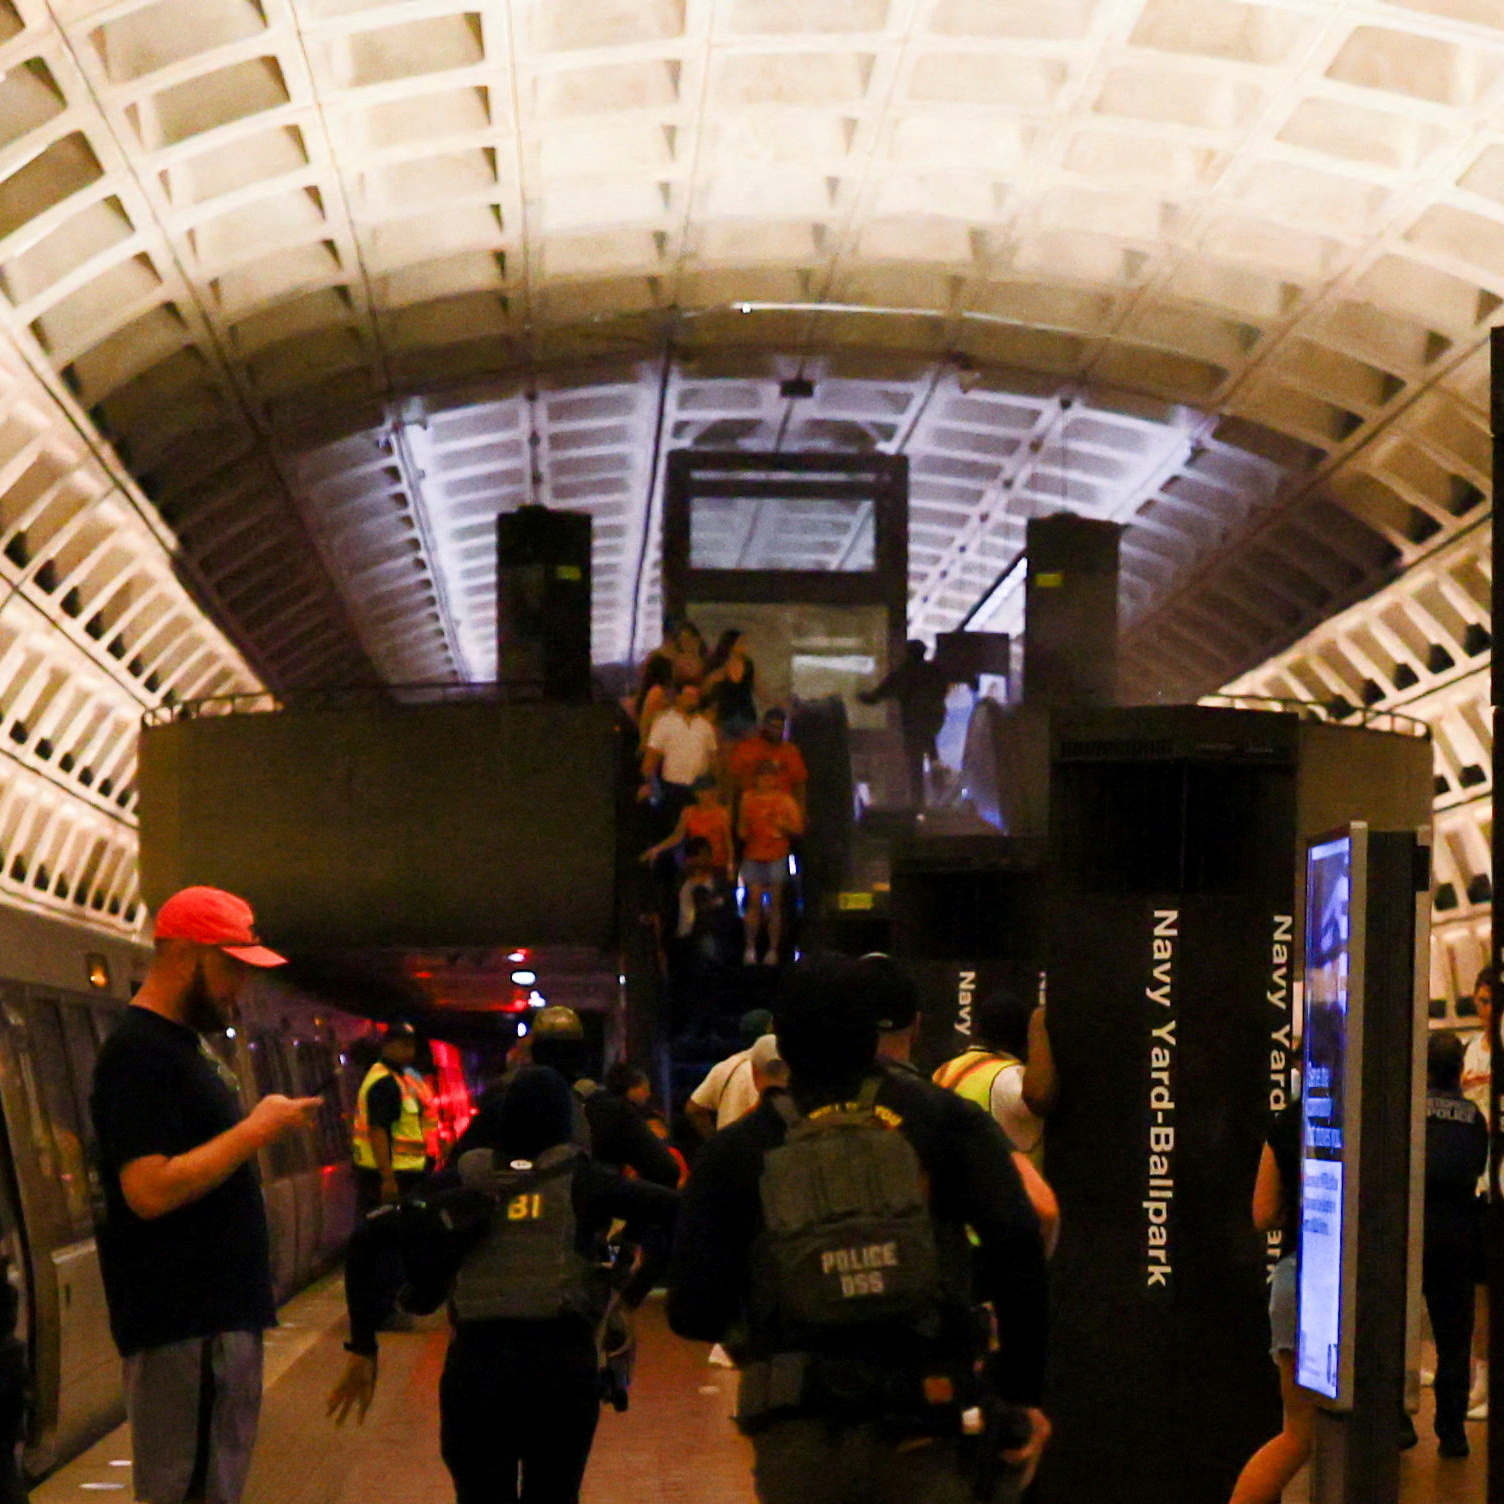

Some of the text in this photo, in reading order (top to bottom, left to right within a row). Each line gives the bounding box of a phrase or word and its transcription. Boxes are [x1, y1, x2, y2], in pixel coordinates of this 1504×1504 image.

[1266, 914, 1293, 1010] Navy
[954, 970, 977, 1036] Navy
[1141, 909, 1179, 1288] Navy Yard-Ballpark
[821, 1242, 898, 1274] POLICE
